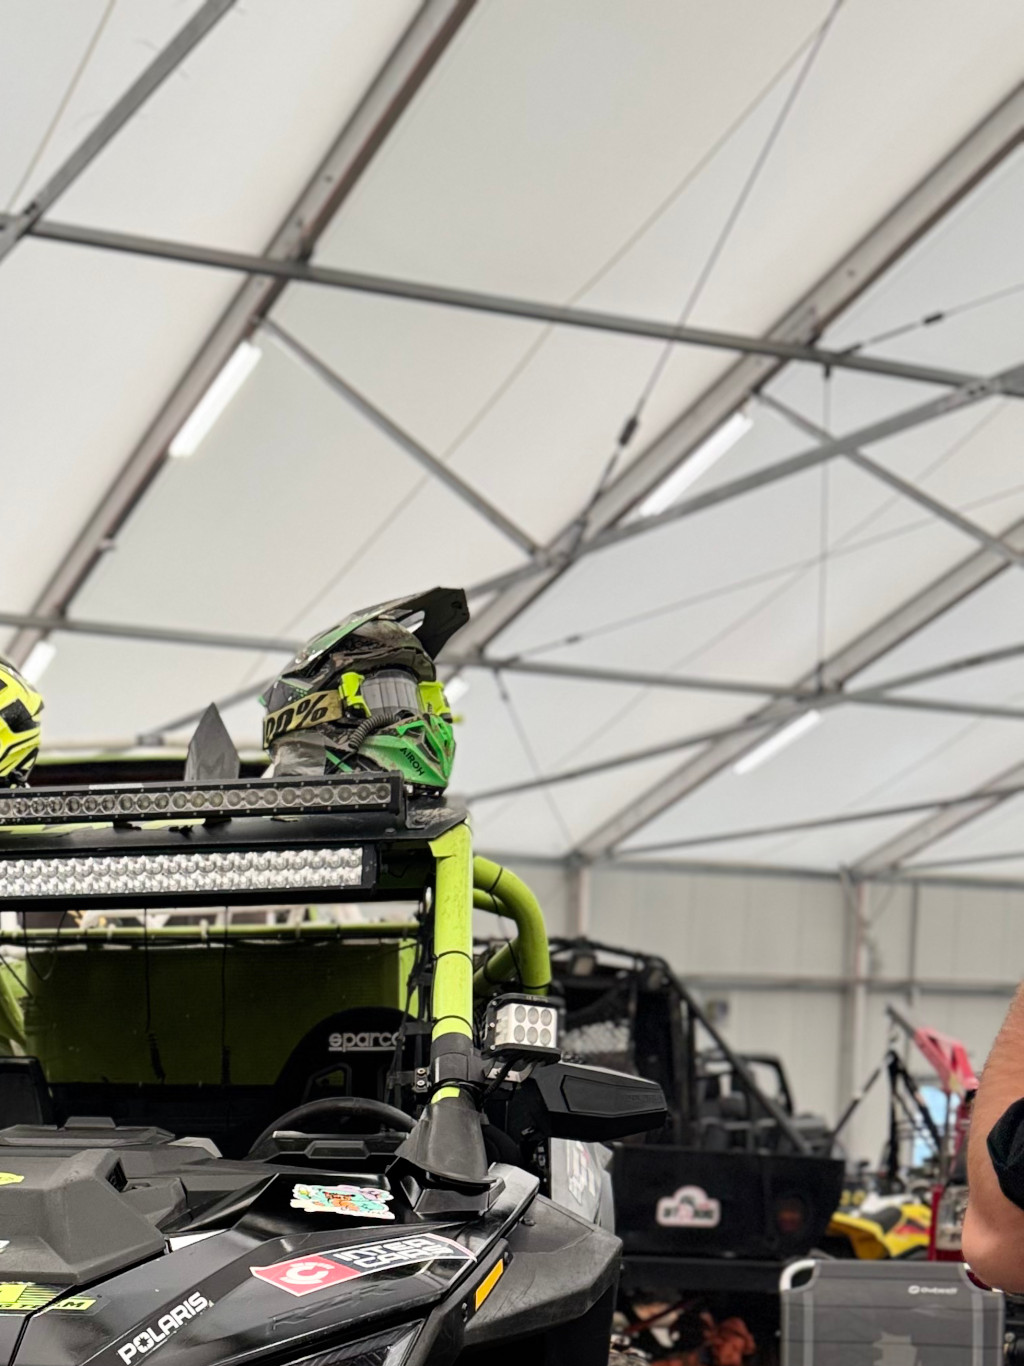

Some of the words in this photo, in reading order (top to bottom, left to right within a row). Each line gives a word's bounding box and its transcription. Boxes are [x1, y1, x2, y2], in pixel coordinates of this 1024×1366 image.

[399, 746, 425, 777] AIROH
[332, 1237, 436, 1263] INTER
[353, 1243, 454, 1269] CARS
[920, 1286, 958, 1296] Outwell
[117, 1292, 209, 1366] POLARIS
